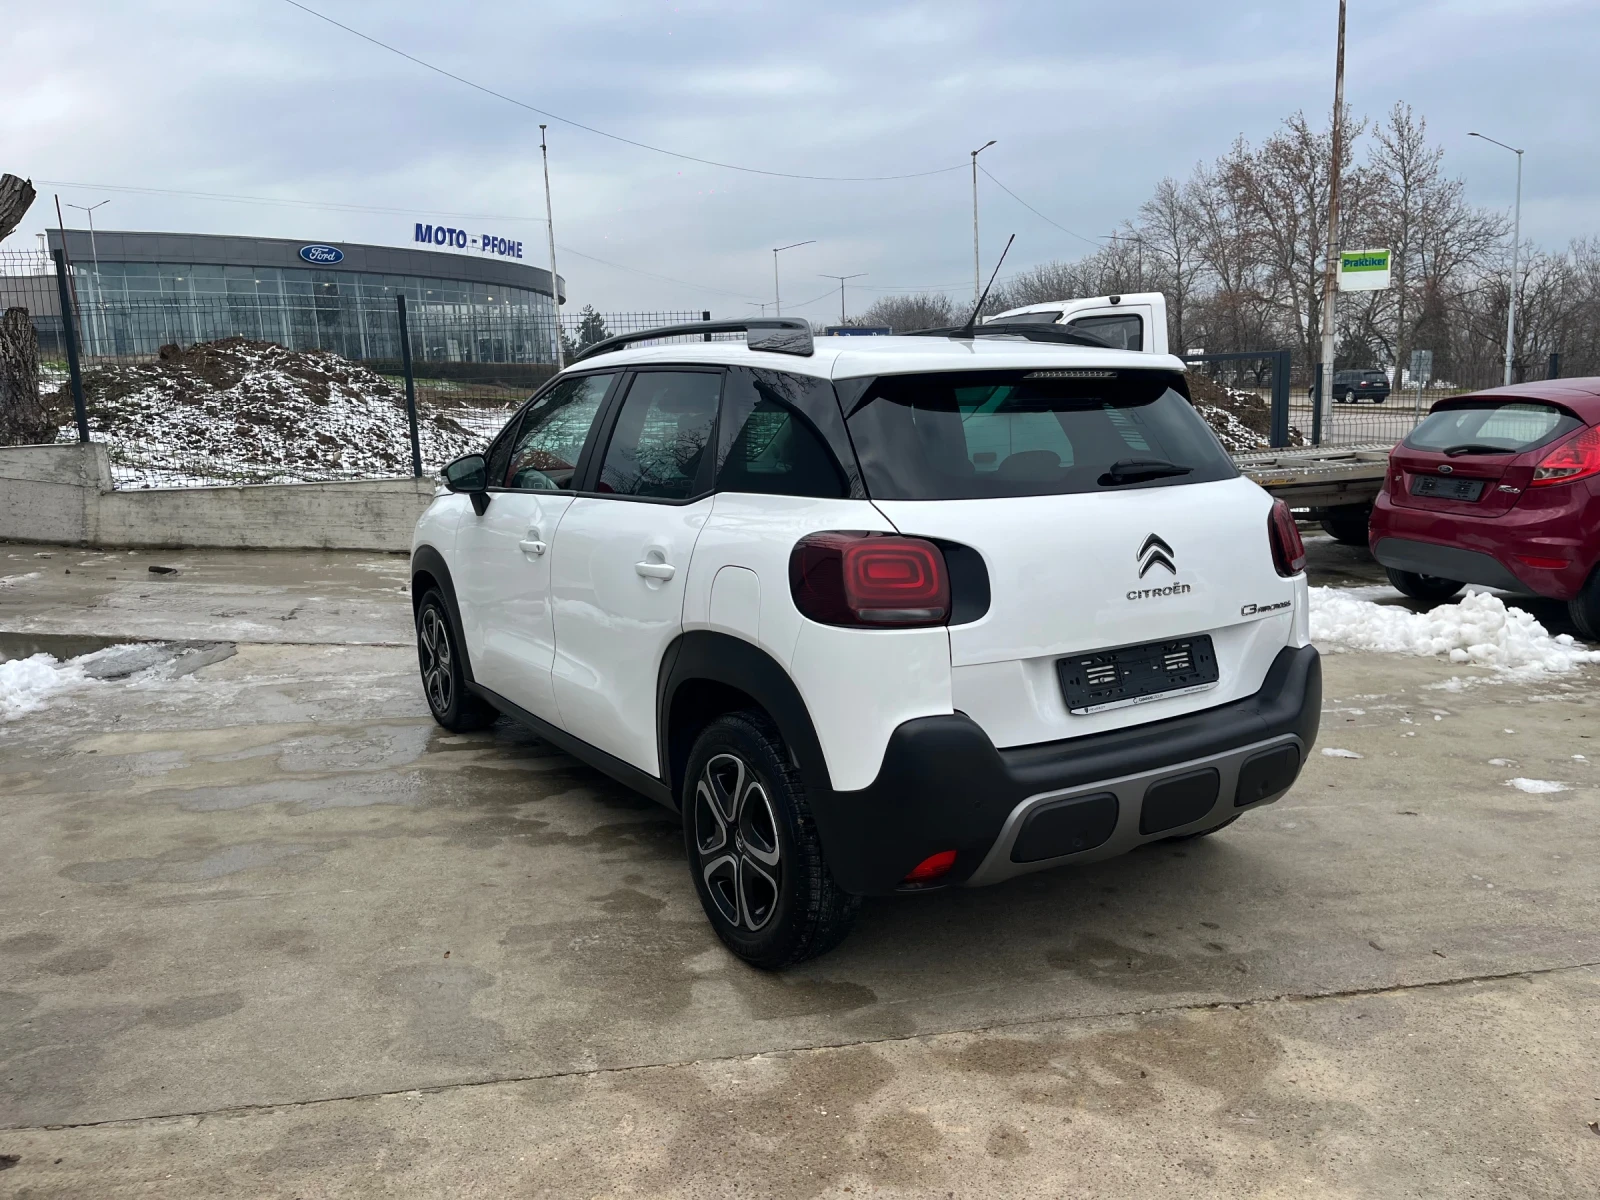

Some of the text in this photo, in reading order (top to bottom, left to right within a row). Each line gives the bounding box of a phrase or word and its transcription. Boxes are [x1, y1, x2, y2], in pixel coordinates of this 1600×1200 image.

[415, 223, 467, 248] MOTO
[482, 234, 523, 258] PFOHE
[309, 247, 336, 261] Ford
[1343, 257, 1387, 268] Praktiker
[1240, 603, 1257, 616] C3
